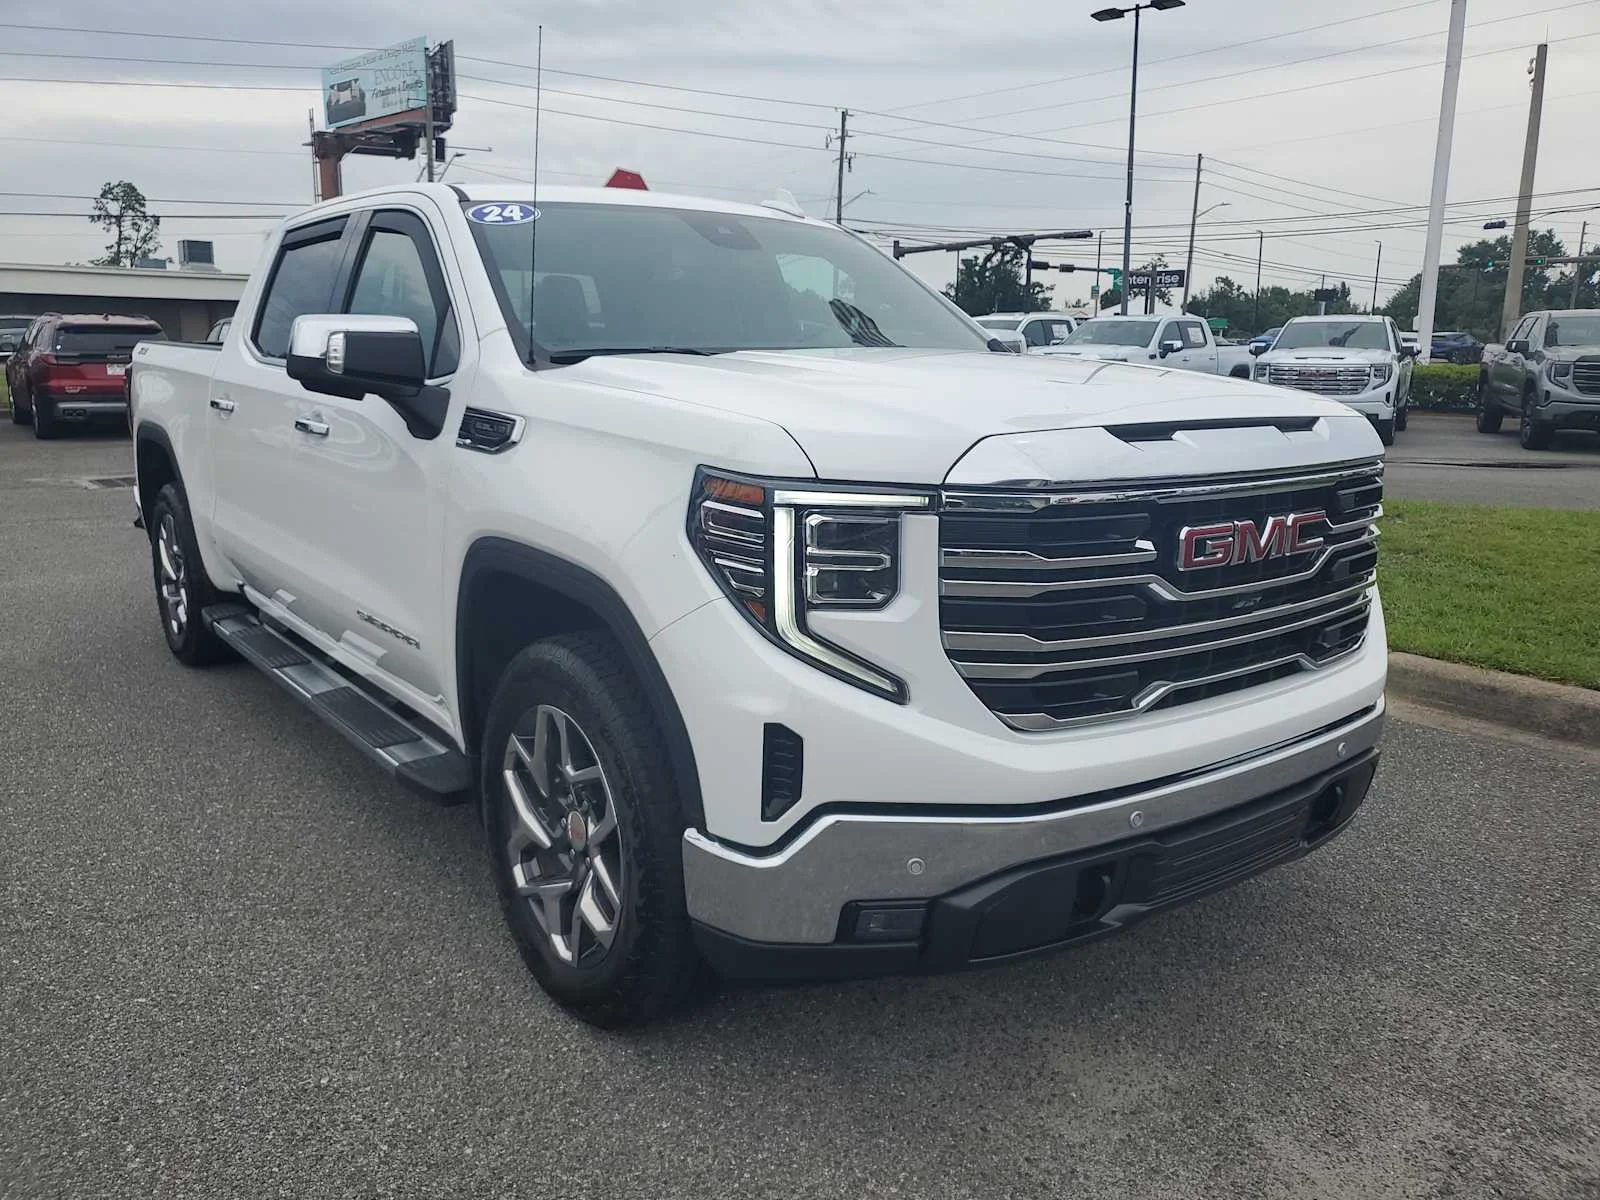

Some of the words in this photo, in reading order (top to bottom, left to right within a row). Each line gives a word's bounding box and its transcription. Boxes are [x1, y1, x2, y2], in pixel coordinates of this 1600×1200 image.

[483, 205, 524, 222] 24
[1116, 272, 1180, 287] enterrise
[1178, 510, 1326, 572] GMC
